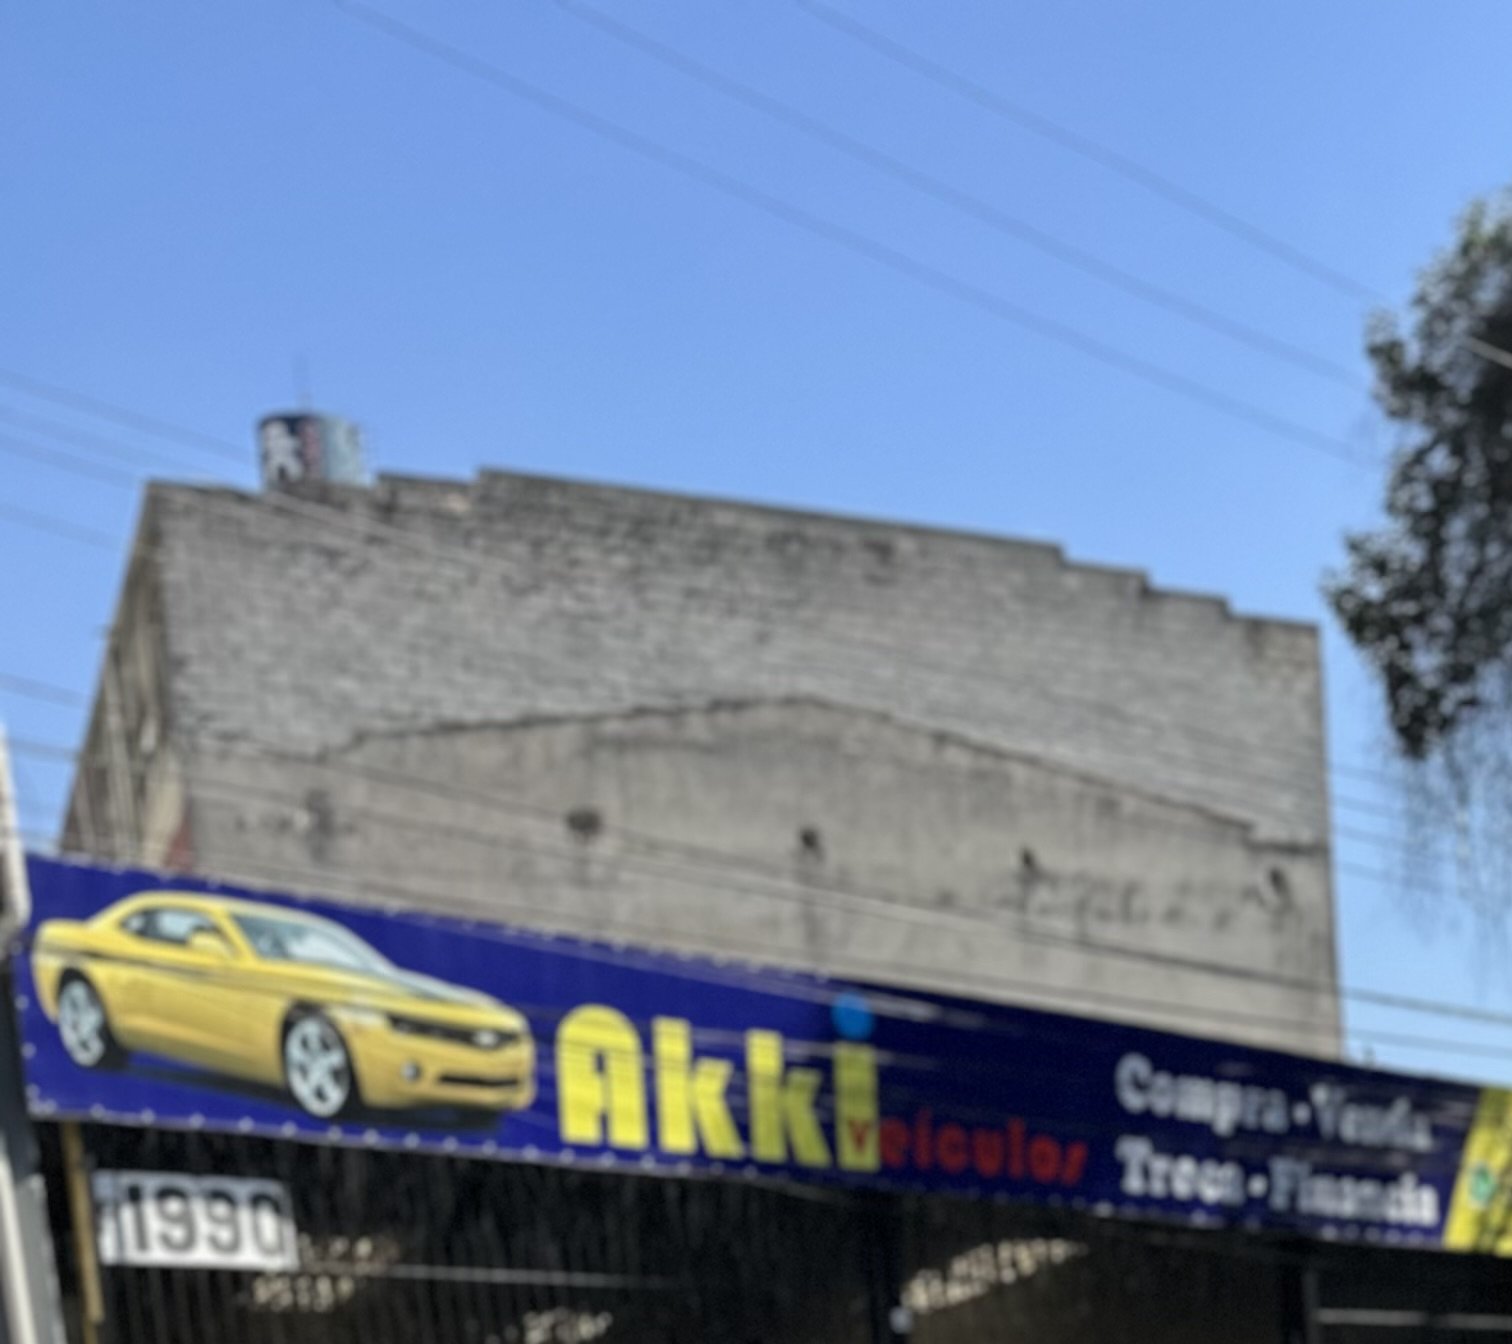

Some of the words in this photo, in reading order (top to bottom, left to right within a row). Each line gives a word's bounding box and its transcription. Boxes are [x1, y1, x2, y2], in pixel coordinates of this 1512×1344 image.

[555, 993, 881, 1171] Akki
[1115, 1053, 1289, 1137] Compra
[1309, 1082, 1431, 1152] Venda
[1114, 1134, 1246, 1206] Troca
[127, 1184, 285, 1255] 1990
